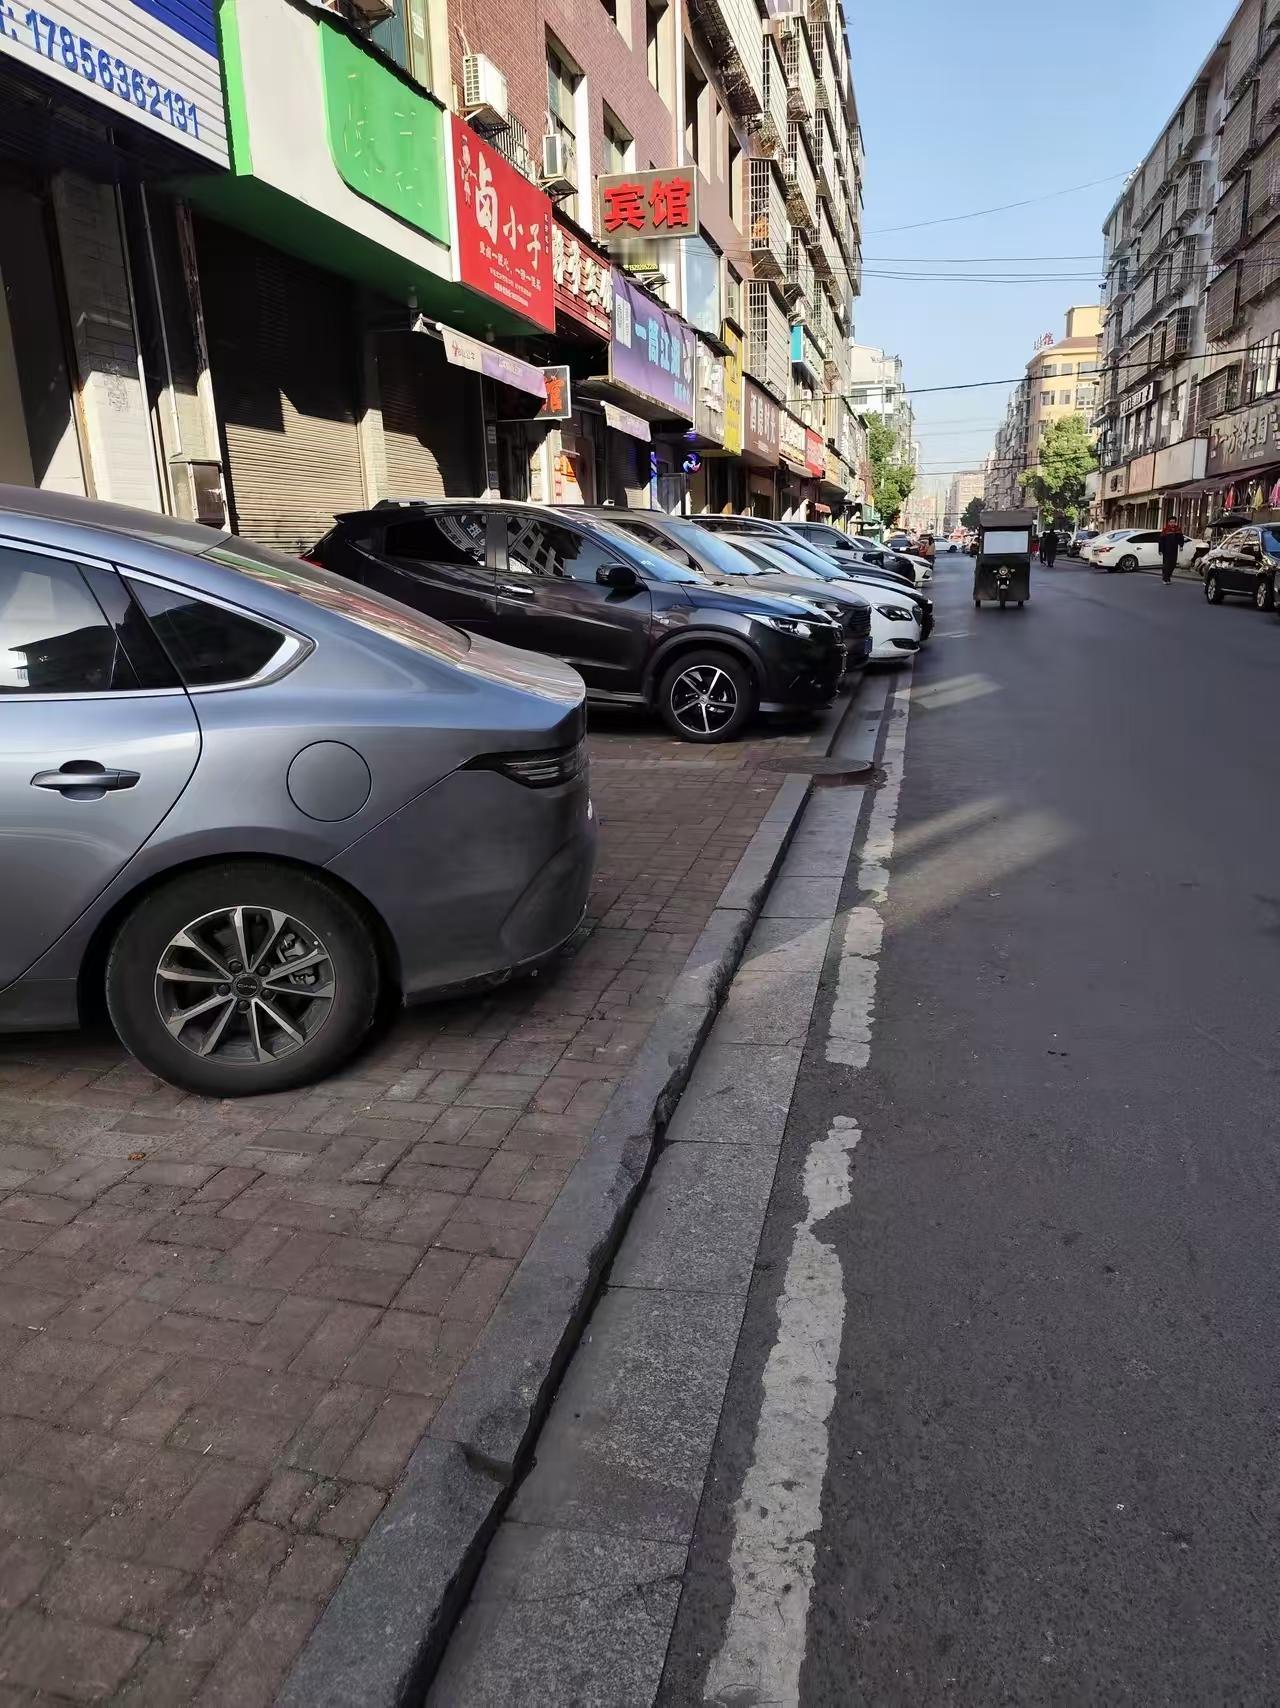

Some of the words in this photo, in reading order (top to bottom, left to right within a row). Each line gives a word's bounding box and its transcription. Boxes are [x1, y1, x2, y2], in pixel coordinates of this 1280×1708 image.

[475, 151, 542, 272] 卤小子
[604, 176, 691, 233] 宾馆
